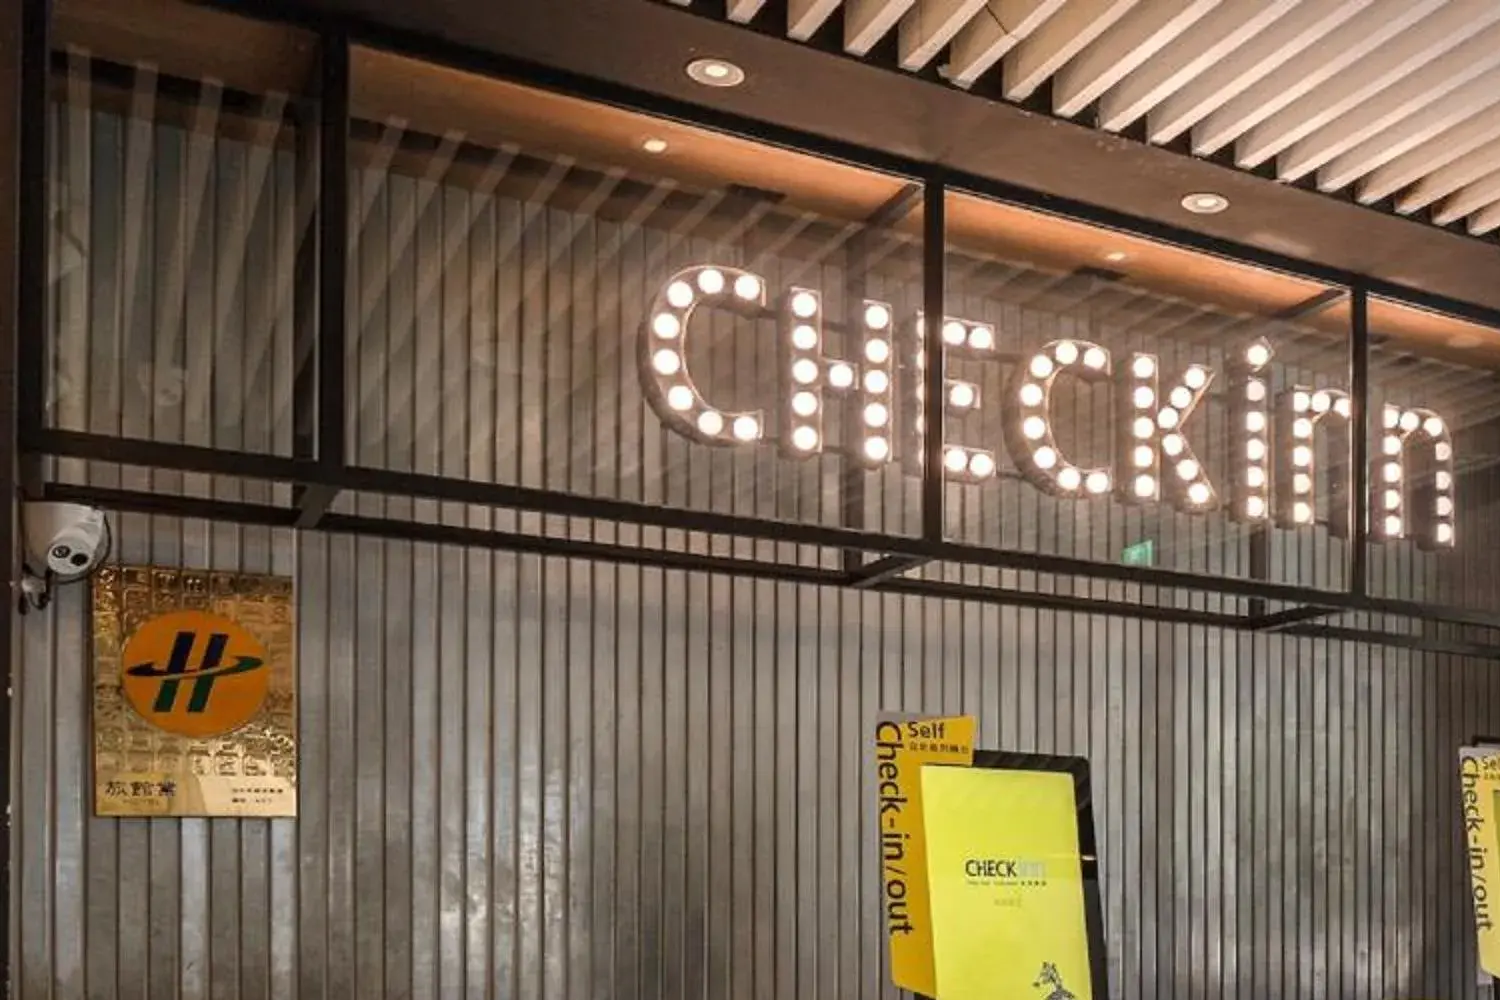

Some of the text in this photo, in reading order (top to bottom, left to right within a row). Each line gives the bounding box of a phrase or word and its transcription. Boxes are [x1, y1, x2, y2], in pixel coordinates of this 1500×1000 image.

[638, 265, 1455, 550] CHECKinn
[907, 721, 945, 739] Self
[876, 721, 914, 936] Check-in/out
[1461, 756, 1493, 931] Check-in/out
